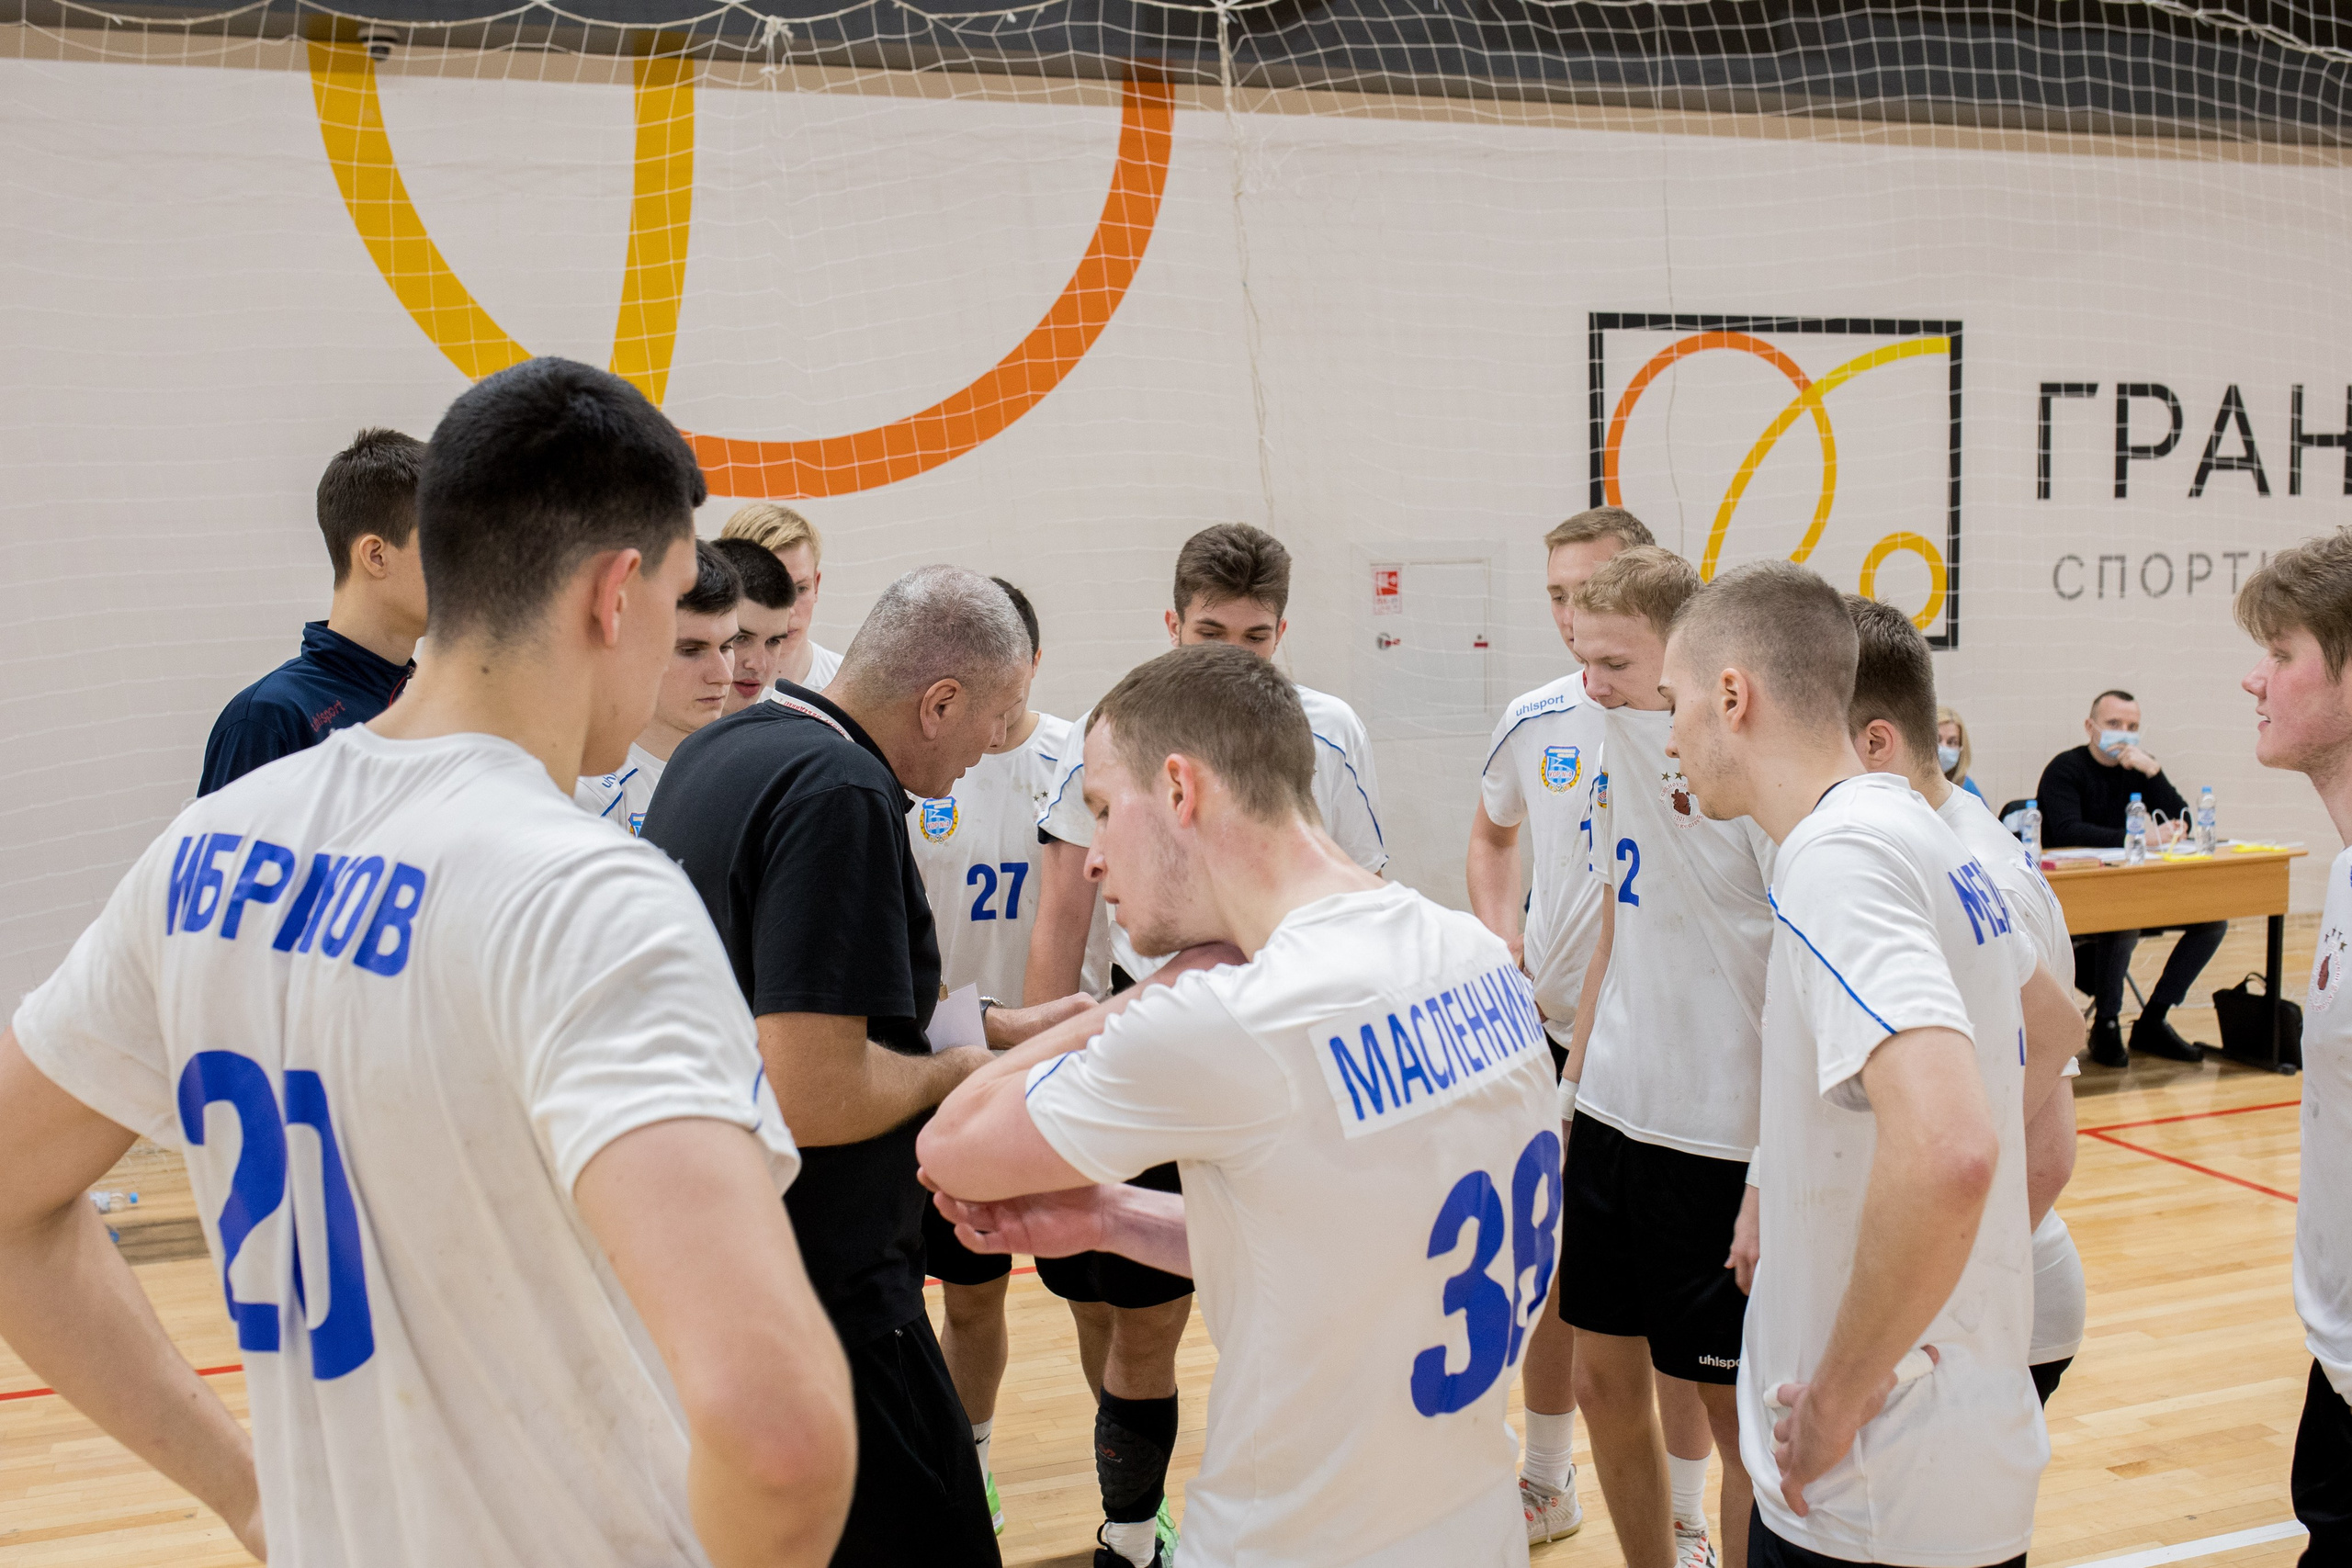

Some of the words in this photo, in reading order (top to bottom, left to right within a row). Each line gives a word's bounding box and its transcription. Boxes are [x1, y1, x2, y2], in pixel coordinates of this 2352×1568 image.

[2052, 550, 2267, 601] СПОРТ
[1515, 694, 1565, 716] uhlsport
[967, 861, 1029, 921] 27
[1615, 837, 1641, 908] 2
[177, 1050, 376, 1381] 20
[1409, 1129, 1563, 1418] 38
[1698, 1354, 1741, 1370] uhlspo
